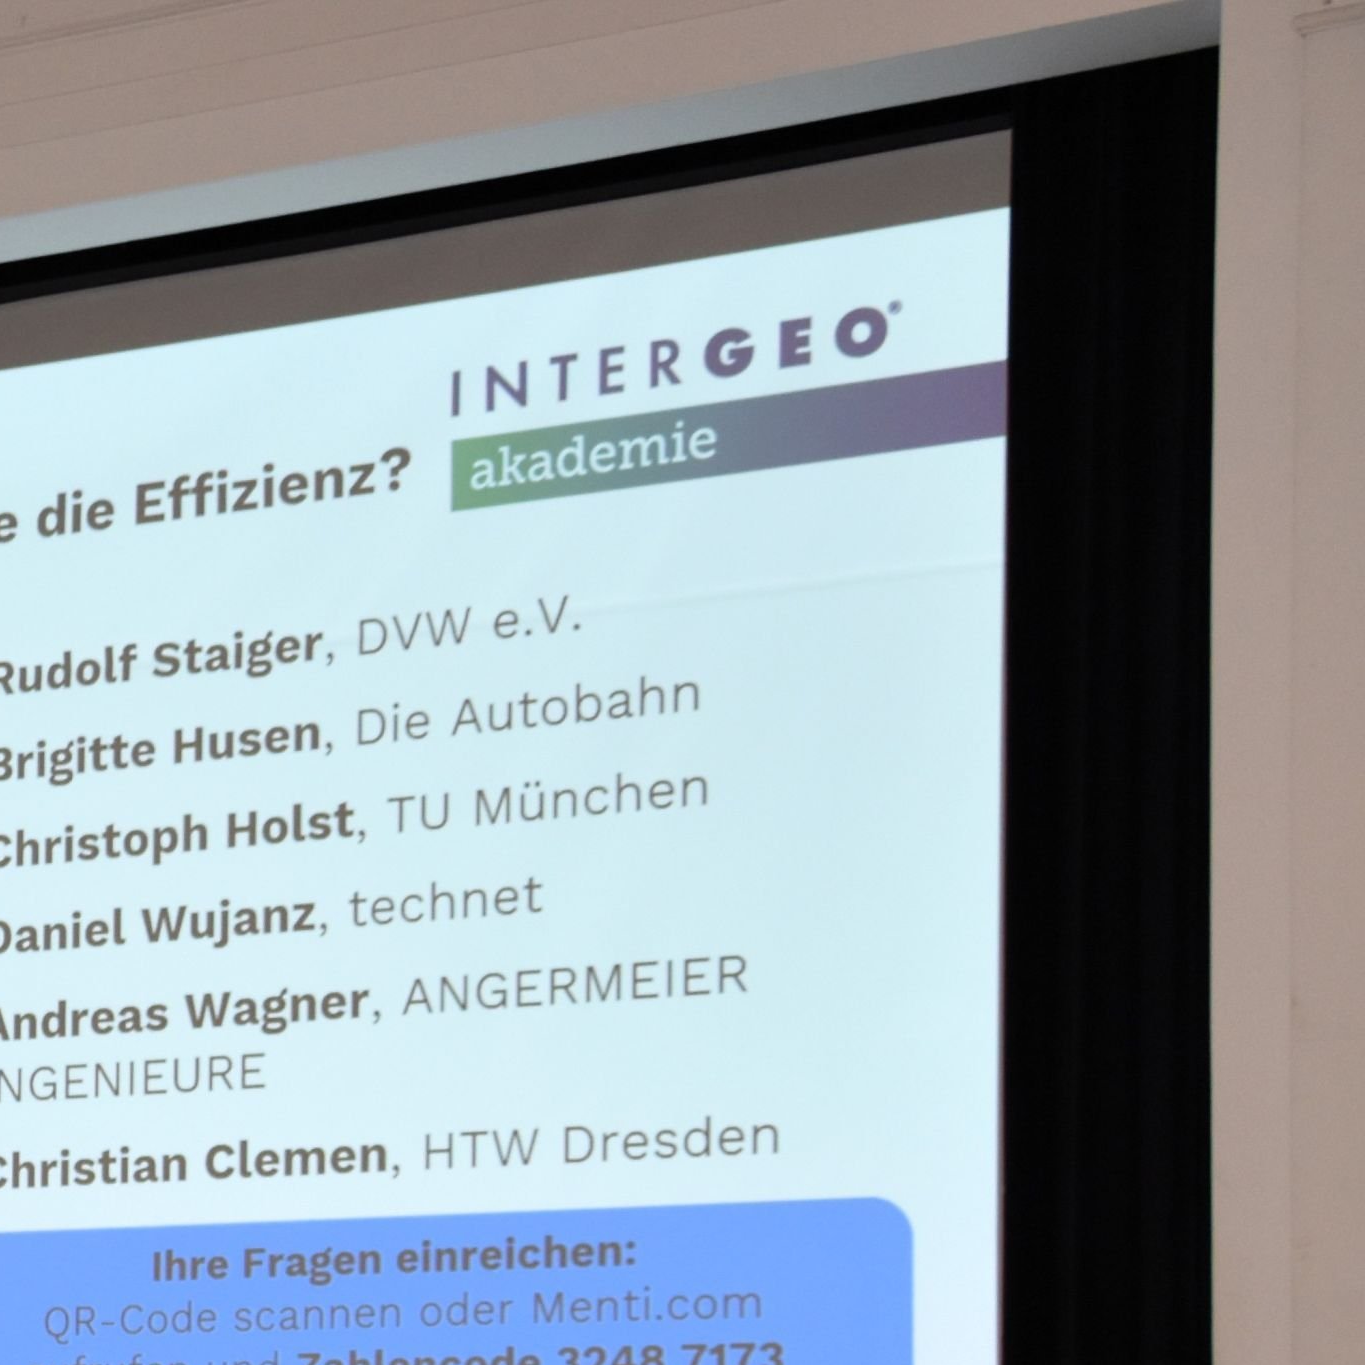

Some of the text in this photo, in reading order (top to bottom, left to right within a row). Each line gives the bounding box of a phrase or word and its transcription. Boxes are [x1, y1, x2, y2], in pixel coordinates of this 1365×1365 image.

[37, 489, 115, 538] die
[135, 446, 412, 525] Effizienz?
[470, 421, 718, 491] akademie
[152, 630, 334, 678] Staiger,
[359, 606, 471, 655] DVW
[493, 595, 581, 639] e.V.
[173, 722, 333, 764] Husen,
[357, 702, 430, 746] Die
[451, 676, 699, 736] Autobahn
[227, 802, 366, 848] Holst,
[387, 792, 449, 833] TU
[476, 772, 707, 826] München
[141, 899, 327, 949] Wujanz,
[349, 877, 543, 927] technet
[184, 987, 381, 1035] Wagner,
[402, 955, 747, 1015] ANGERMEIER
[205, 1139, 400, 1180] Clemen,
[425, 1128, 539, 1170] HTW
[564, 1116, 779, 1164] Dresden
[154, 1235, 634, 1286] Ihre Fragen einreichen:
[46, 1292, 760, 1344] QR-Code scannen oder Menti.com
